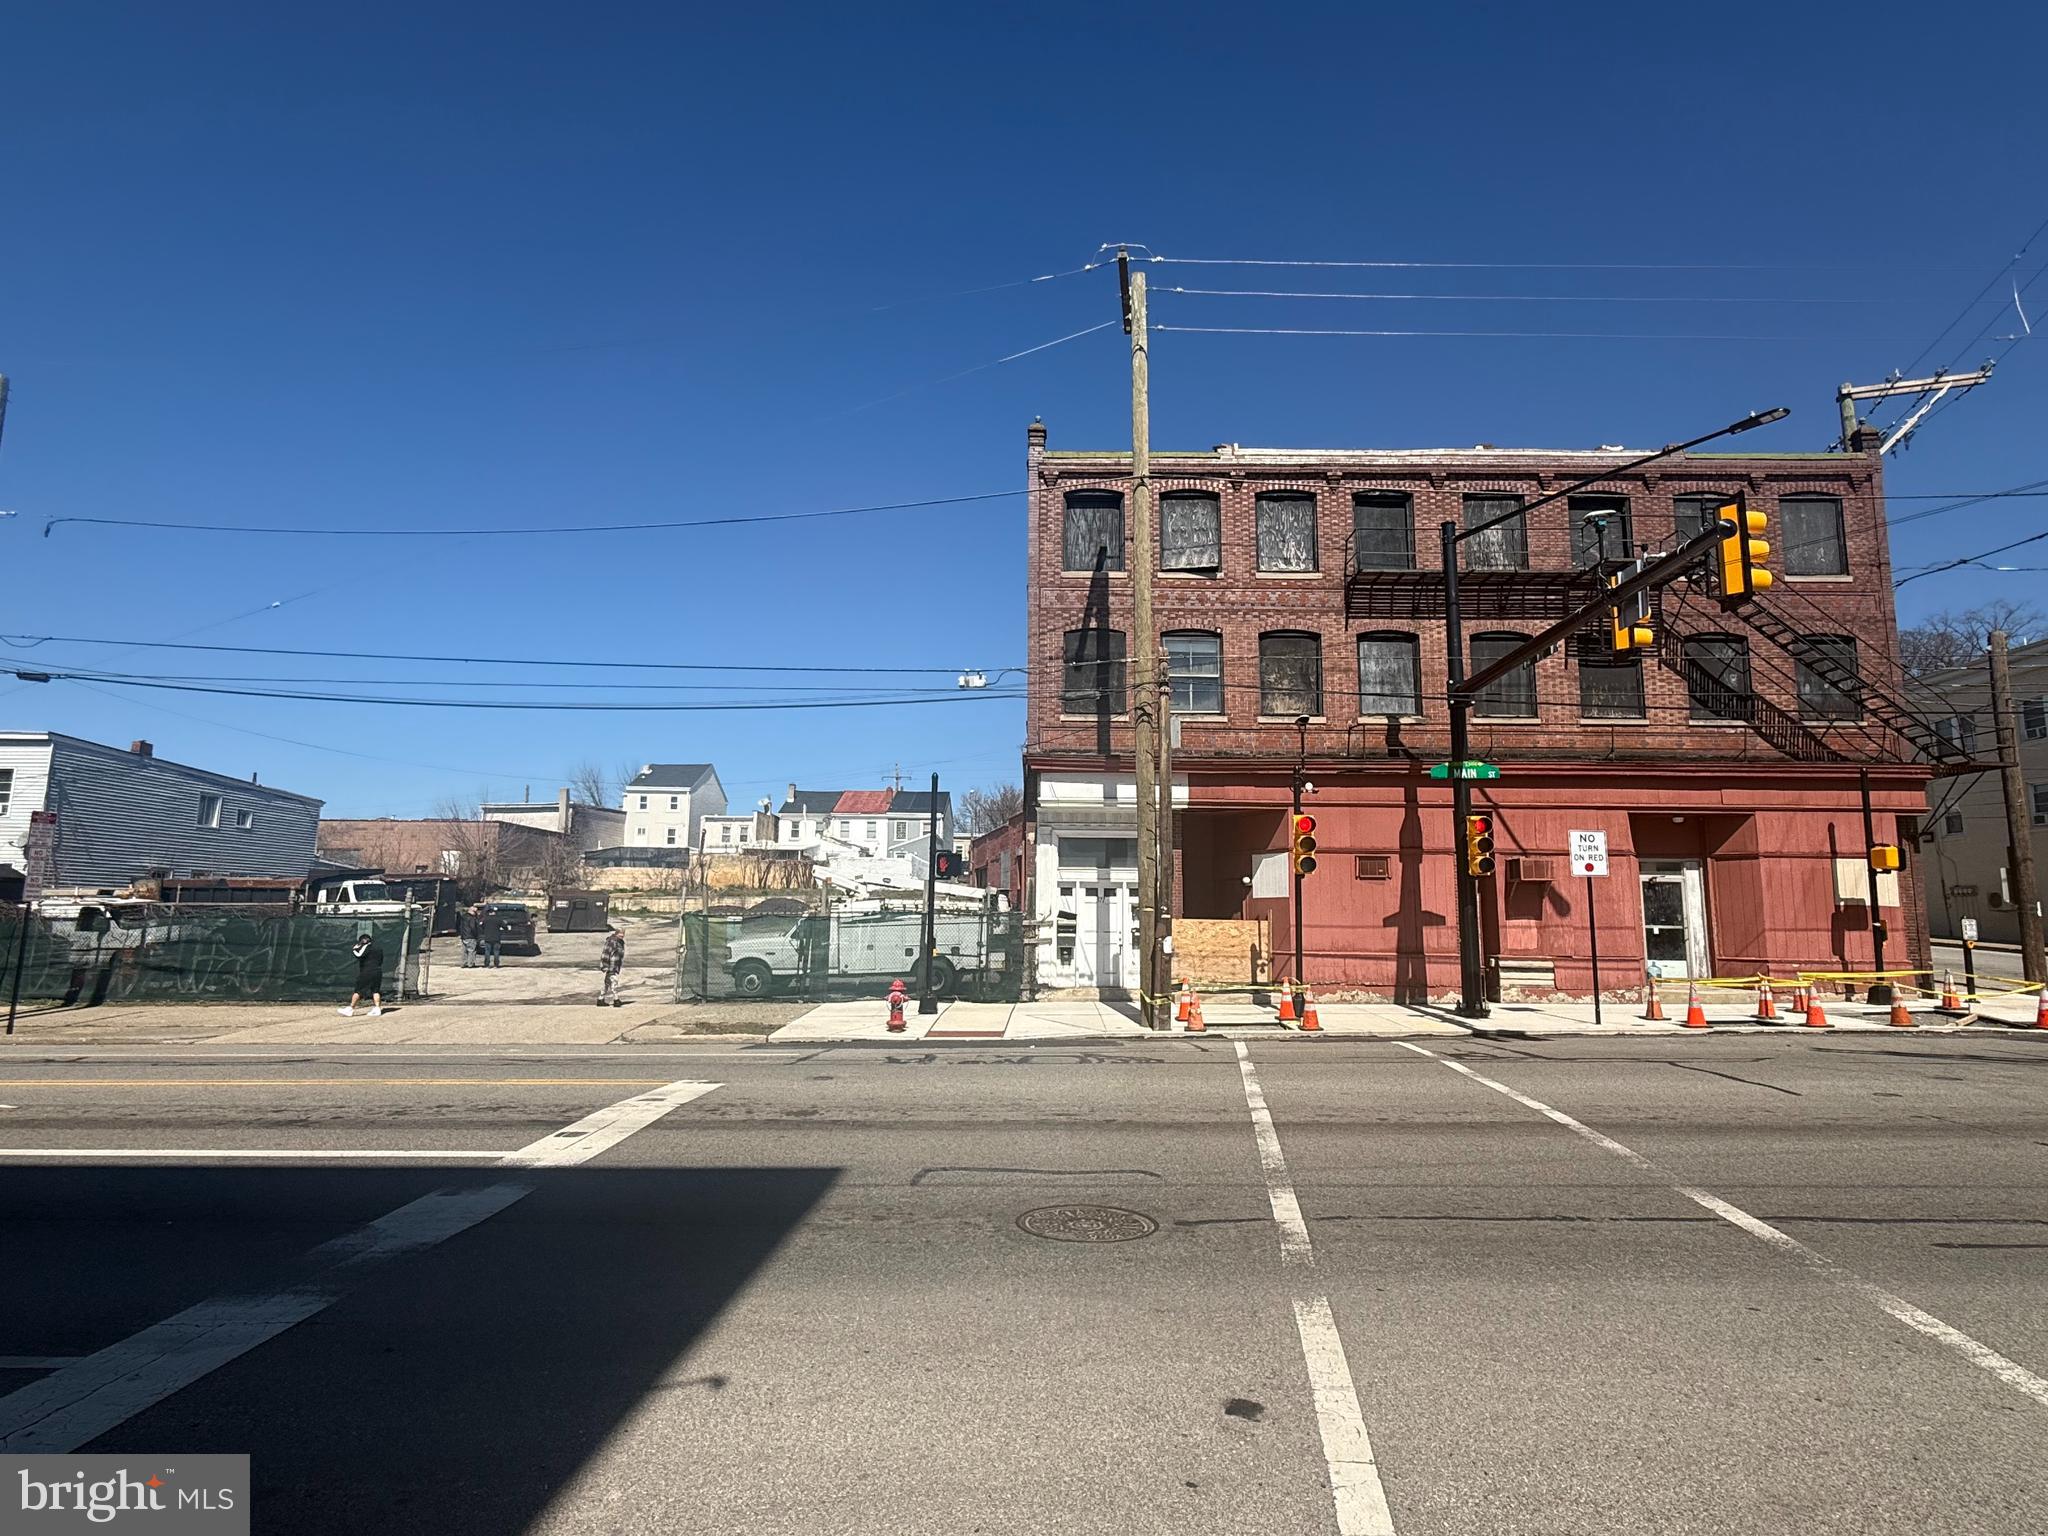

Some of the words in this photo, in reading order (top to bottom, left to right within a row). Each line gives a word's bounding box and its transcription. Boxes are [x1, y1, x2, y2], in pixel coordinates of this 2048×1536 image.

[1453, 768, 1477, 779] MAIN
[1487, 771, 1496, 779] ST
[1579, 834, 1595, 843] NO
[1578, 844, 1599, 852] TURN
[1574, 853, 1585, 861] ON
[1588, 854, 1604, 862] RED
